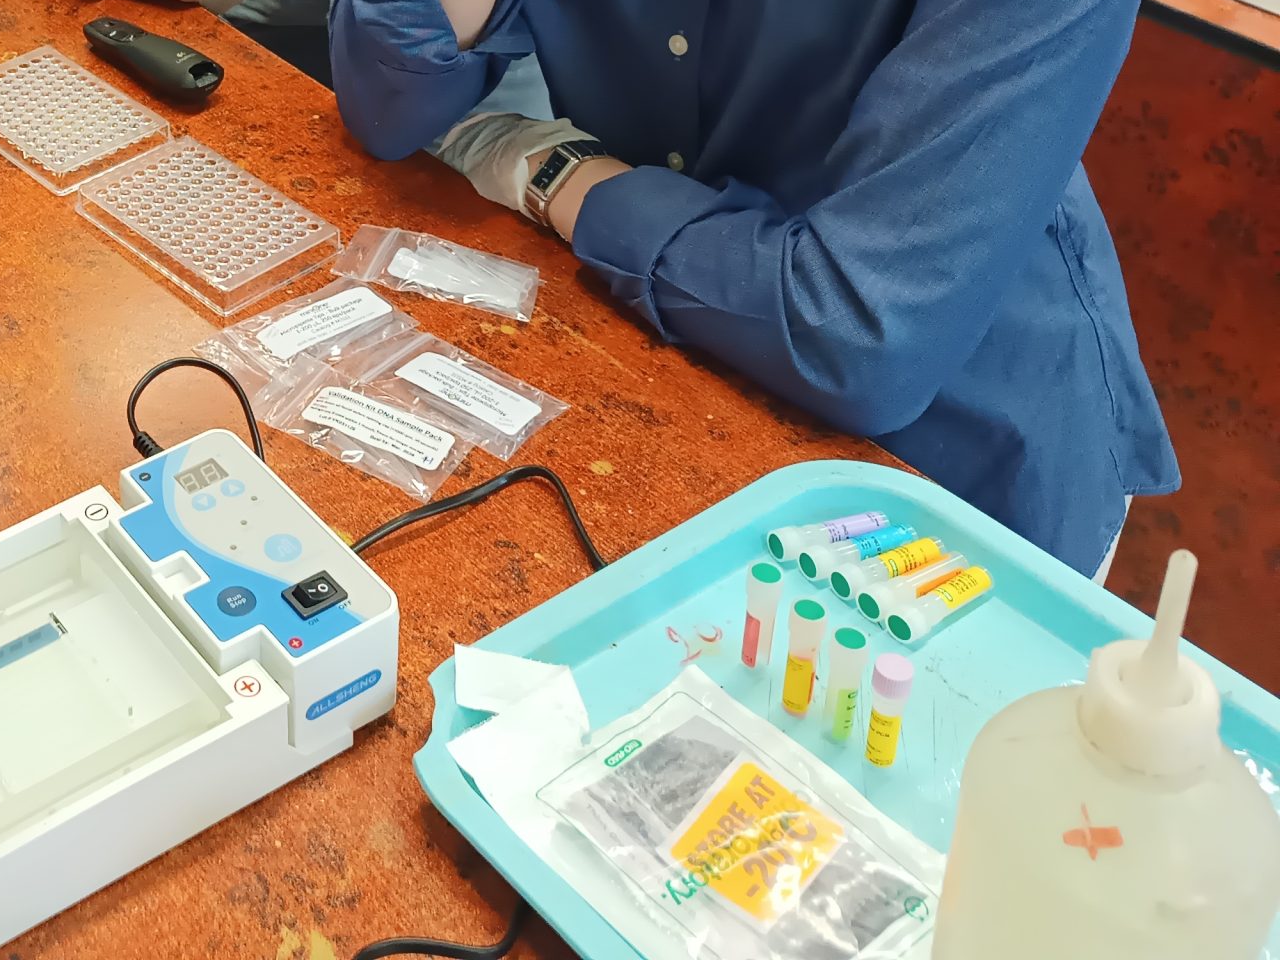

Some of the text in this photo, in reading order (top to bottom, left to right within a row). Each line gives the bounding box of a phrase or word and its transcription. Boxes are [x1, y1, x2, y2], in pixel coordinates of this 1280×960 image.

[377, 408, 394, 420] DNA
[395, 417, 424, 434] Sample
[424, 430, 443, 442] Pack
[226, 593, 241, 604] Run
[230, 597, 246, 609] Stop
[338, 599, 352, 610] OFF
[308, 617, 320, 626] ON
[311, 673, 378, 717] ALLSHENG
[744, 774, 776, 810] AT
